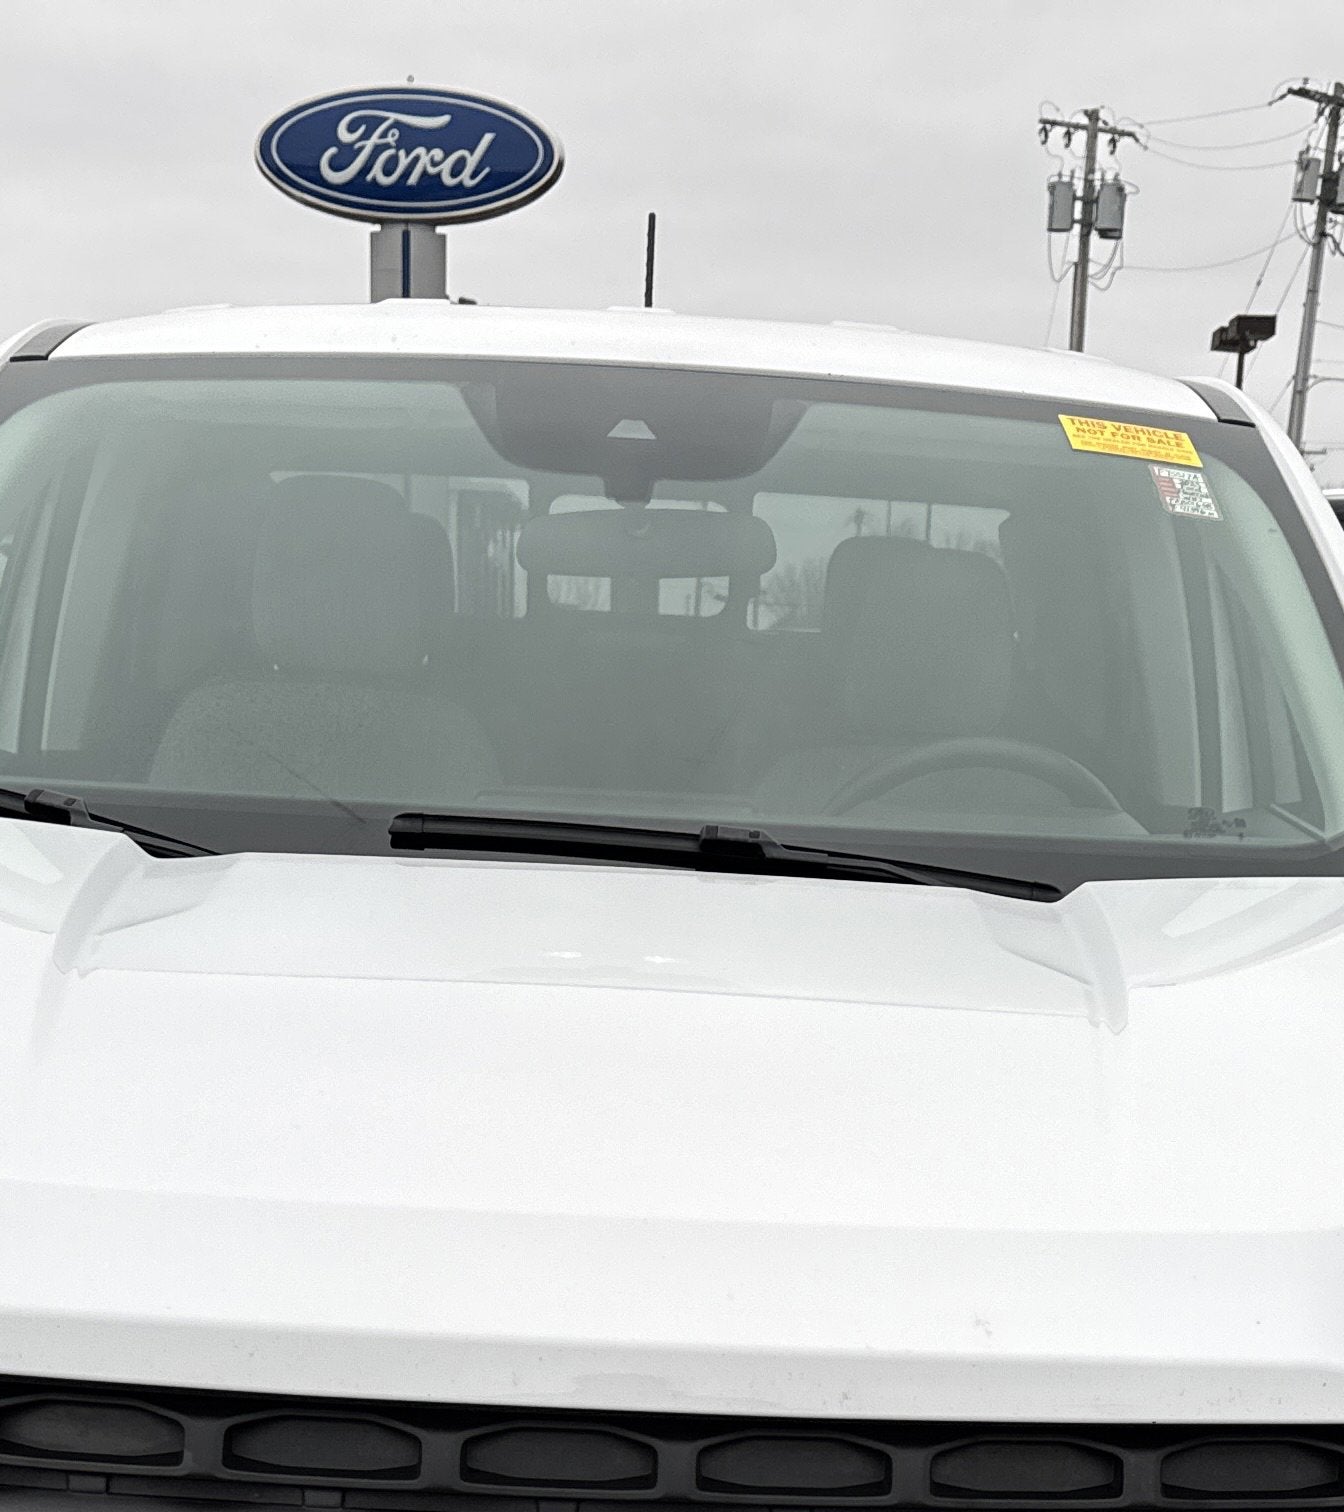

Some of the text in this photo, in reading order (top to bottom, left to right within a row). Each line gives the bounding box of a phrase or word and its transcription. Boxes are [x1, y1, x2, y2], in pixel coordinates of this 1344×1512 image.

[319, 108, 497, 189] Ford
[1066, 418, 1183, 440] THIS VEHICLE
[1076, 426, 1105, 437] NOT
[1111, 431, 1141, 441] FOR
[1147, 437, 1185, 448] SALE
